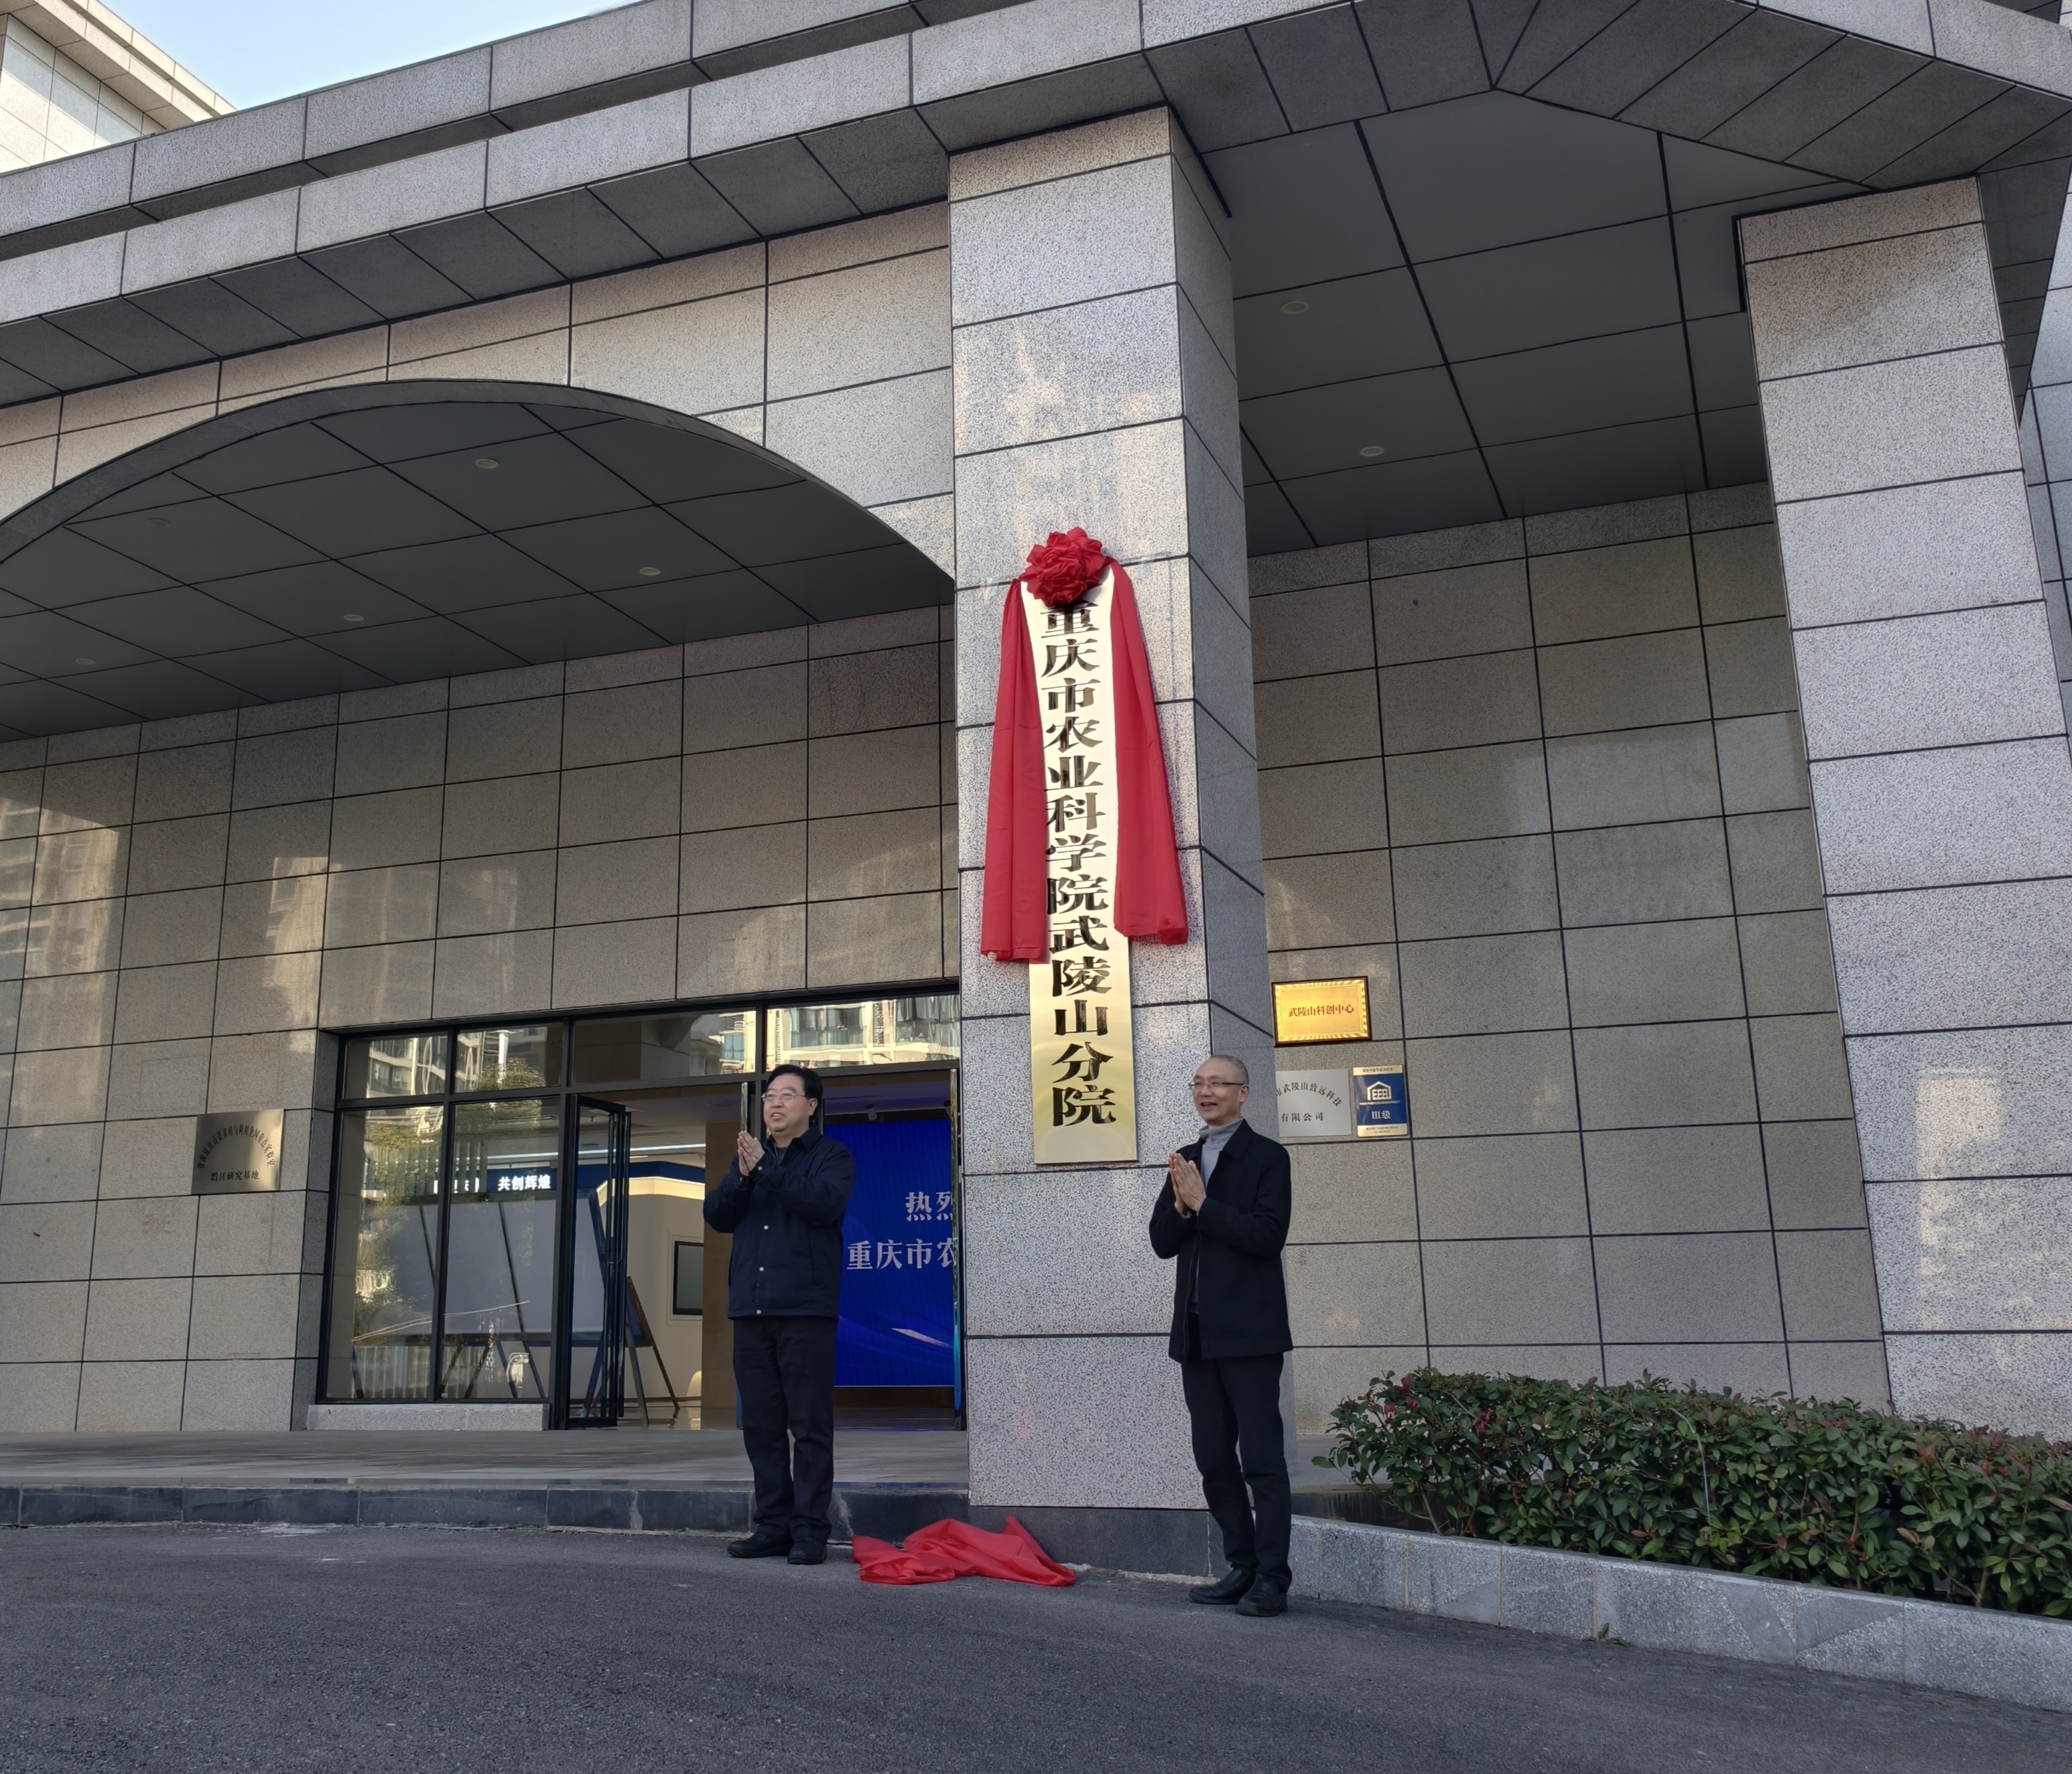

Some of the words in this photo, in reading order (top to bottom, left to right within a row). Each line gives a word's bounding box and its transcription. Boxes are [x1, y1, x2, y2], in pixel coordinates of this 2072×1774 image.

[1041, 598, 1118, 1128] 重庆市农业科学院武陵山分院
[1289, 1004, 1354, 1017] 武陵山科创中心
[1281, 1111, 1323, 1123] 有限公司
[210, 1170, 260, 1181] 黔江研究基地
[498, 1174, 552, 1191] 共创辉煌
